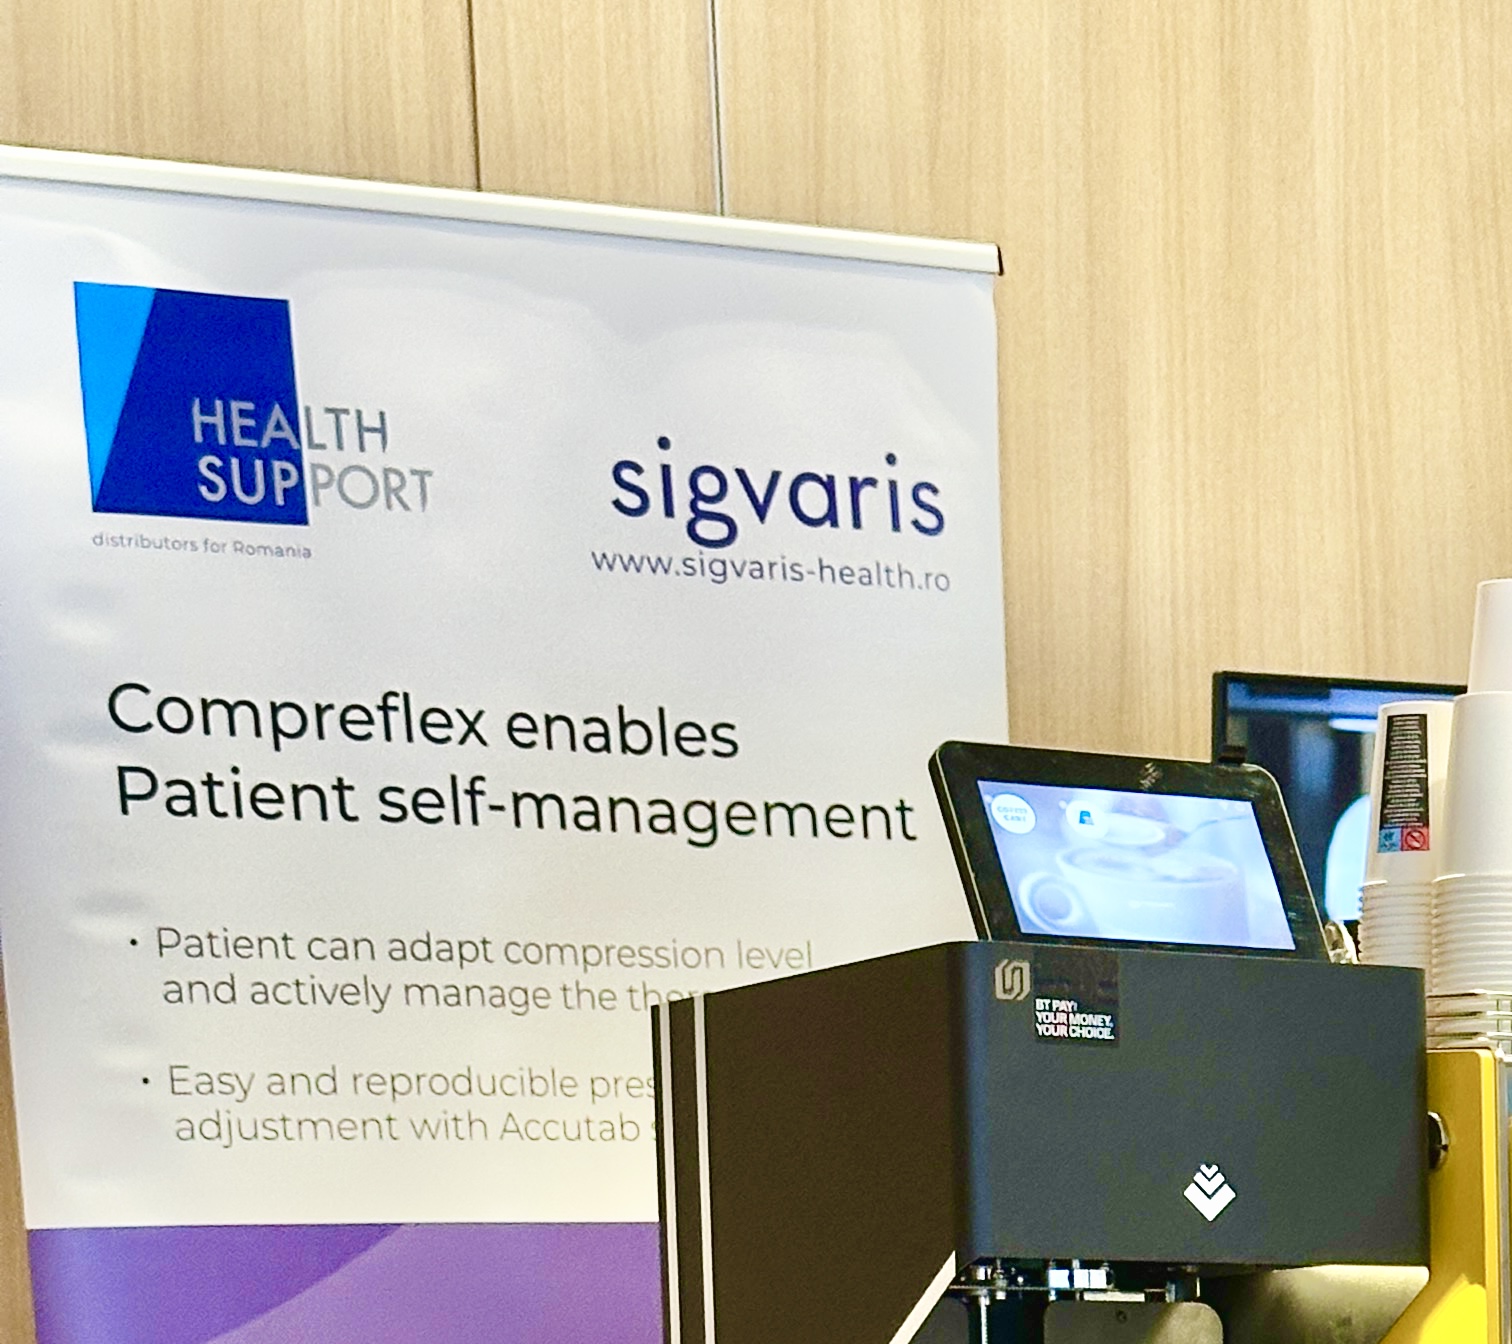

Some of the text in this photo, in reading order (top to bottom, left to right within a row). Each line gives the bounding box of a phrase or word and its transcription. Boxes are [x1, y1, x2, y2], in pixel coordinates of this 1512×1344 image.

[191, 397, 389, 454] HEALTH
[199, 456, 434, 513] SUPPORT
[611, 435, 947, 549] sigvaris
[92, 532, 312, 559] distributors for Romania
[591, 548, 952, 594] www.sigvaris-health.ro
[107, 680, 740, 759] Compreflex enables
[116, 762, 919, 847] Patient self-management
[156, 926, 813, 973] Patient can adapt compression level
[163, 973, 238, 1007] and
[249, 974, 392, 1015] actively
[403, 981, 552, 1017] manage
[560, 980, 618, 1011] the
[1035, 998, 1051, 1011] BT
[1035, 1012, 1114, 1028] YOUR MONEY.
[1035, 1023, 1115, 1040] YOUR CHOICE.
[168, 1064, 252, 1102] Easy
[266, 1063, 338, 1099] and
[351, 1066, 579, 1104] reproducible
[175, 1108, 400, 1150] adjustment
[410, 1108, 489, 1143] with
[499, 1111, 641, 1143] Accutab
